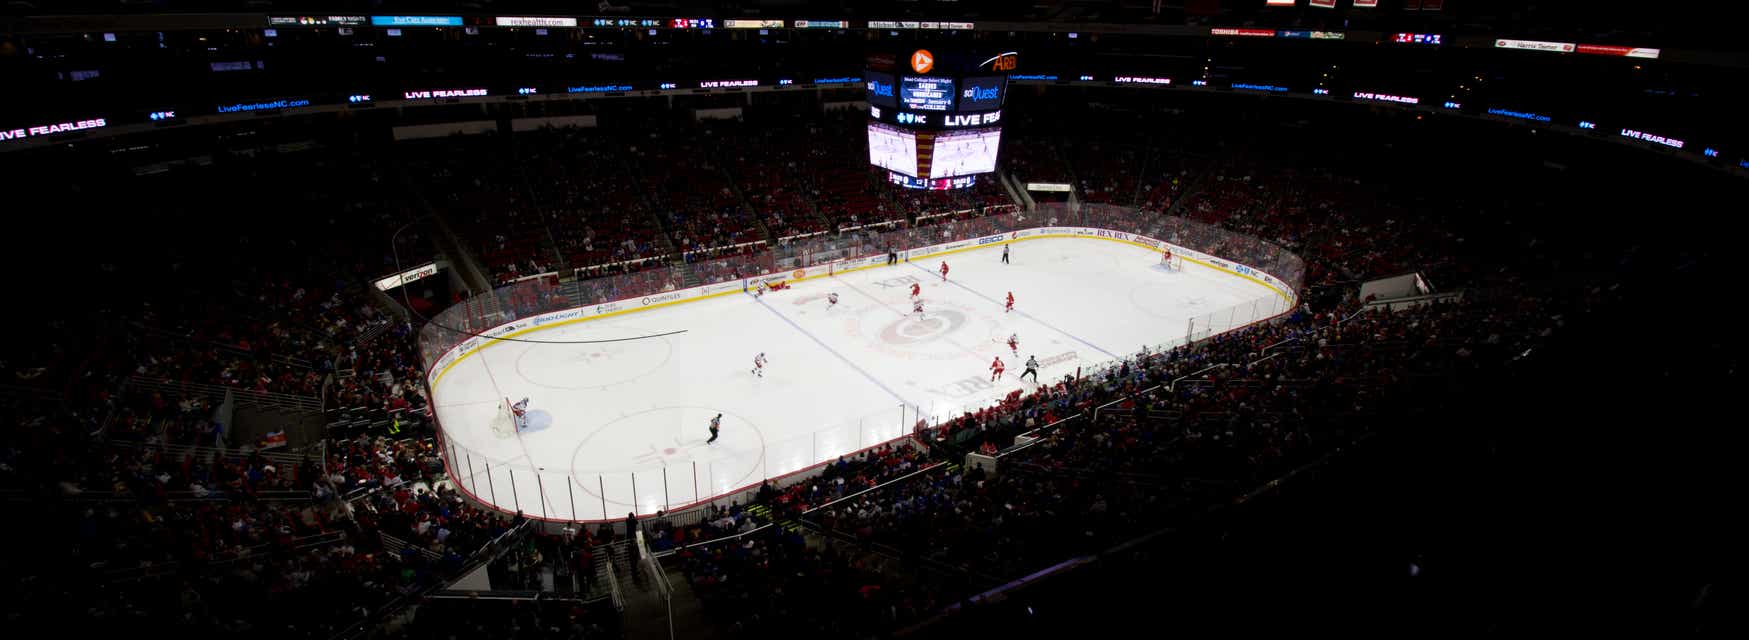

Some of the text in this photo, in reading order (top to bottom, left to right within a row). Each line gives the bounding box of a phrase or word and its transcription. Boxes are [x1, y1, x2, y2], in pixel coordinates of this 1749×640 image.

[405, 89, 488, 99] LIVE FEARLESS
[963, 86, 1000, 102] sciQuest
[1375, 93, 1419, 104] FEARLESS
[217, 99, 310, 113] LiveFearlessNC.com
[914, 115, 927, 124] NC
[944, 114, 980, 126] LIVE
[0, 118, 106, 141] IVE FEARLESS
[1621, 128, 1684, 149] LIVE FEARLESS
[978, 235, 1004, 245] GEICO
[1097, 229, 1112, 238] REX
[1114, 232, 1129, 241] REX
[403, 267, 433, 282] verizon
